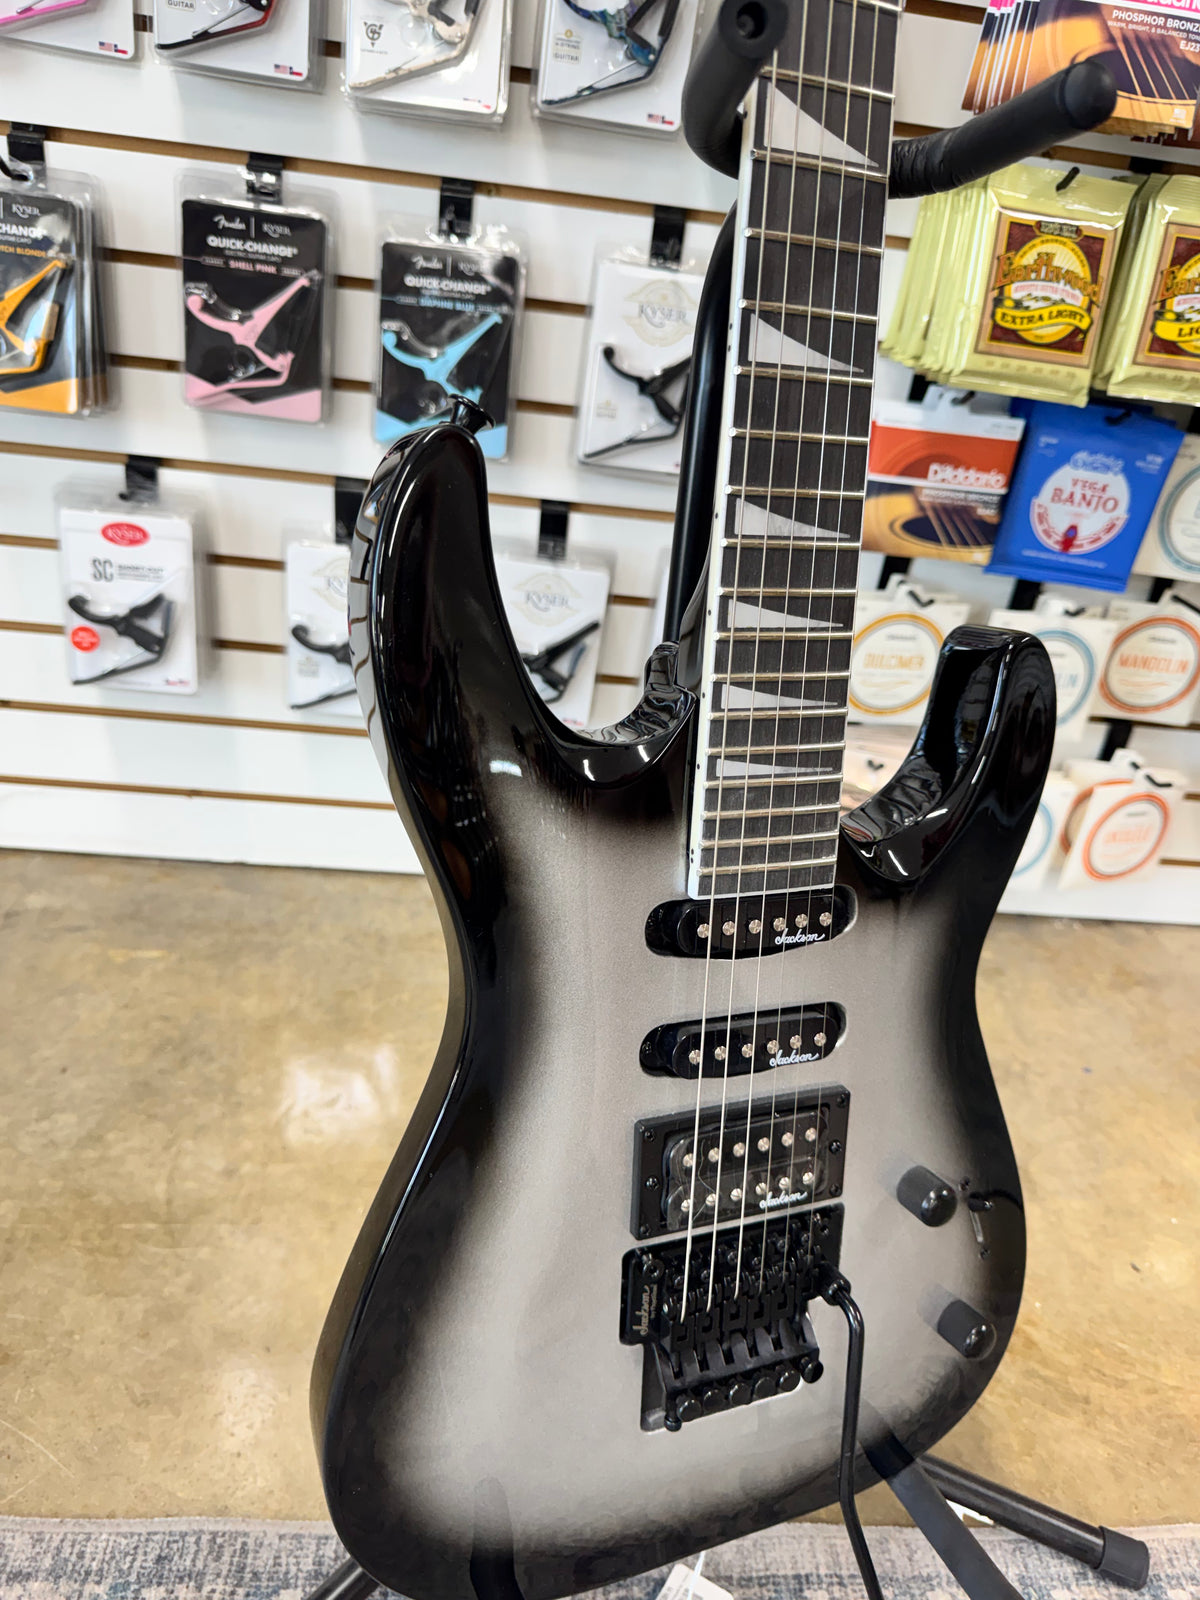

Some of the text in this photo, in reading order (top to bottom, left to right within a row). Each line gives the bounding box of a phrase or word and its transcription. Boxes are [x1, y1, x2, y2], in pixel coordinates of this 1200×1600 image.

[167, 0, 195, 9] GUITAR
[1111, 10, 1165, 27] PHOSPHOR
[1128, 23, 1150, 33] BRIGHT,
[1156, 28, 1187, 39] BALANCED
[213, 214, 247, 230] Fender
[228, 259, 254, 272] SHELL
[256, 263, 278, 274] PINK
[992, 250, 1103, 309] Earthwood
[1001, 307, 1085, 327] EXTRA LIGHT
[1050, 486, 1119, 514] BANJO
[91, 556, 115, 583] SC
[1118, 652, 1189, 675] MANDOLIN
[774, 928, 825, 945] Jackson
[769, 1049, 819, 1067] Jackson
[632, 1284, 650, 1336] Jackson
